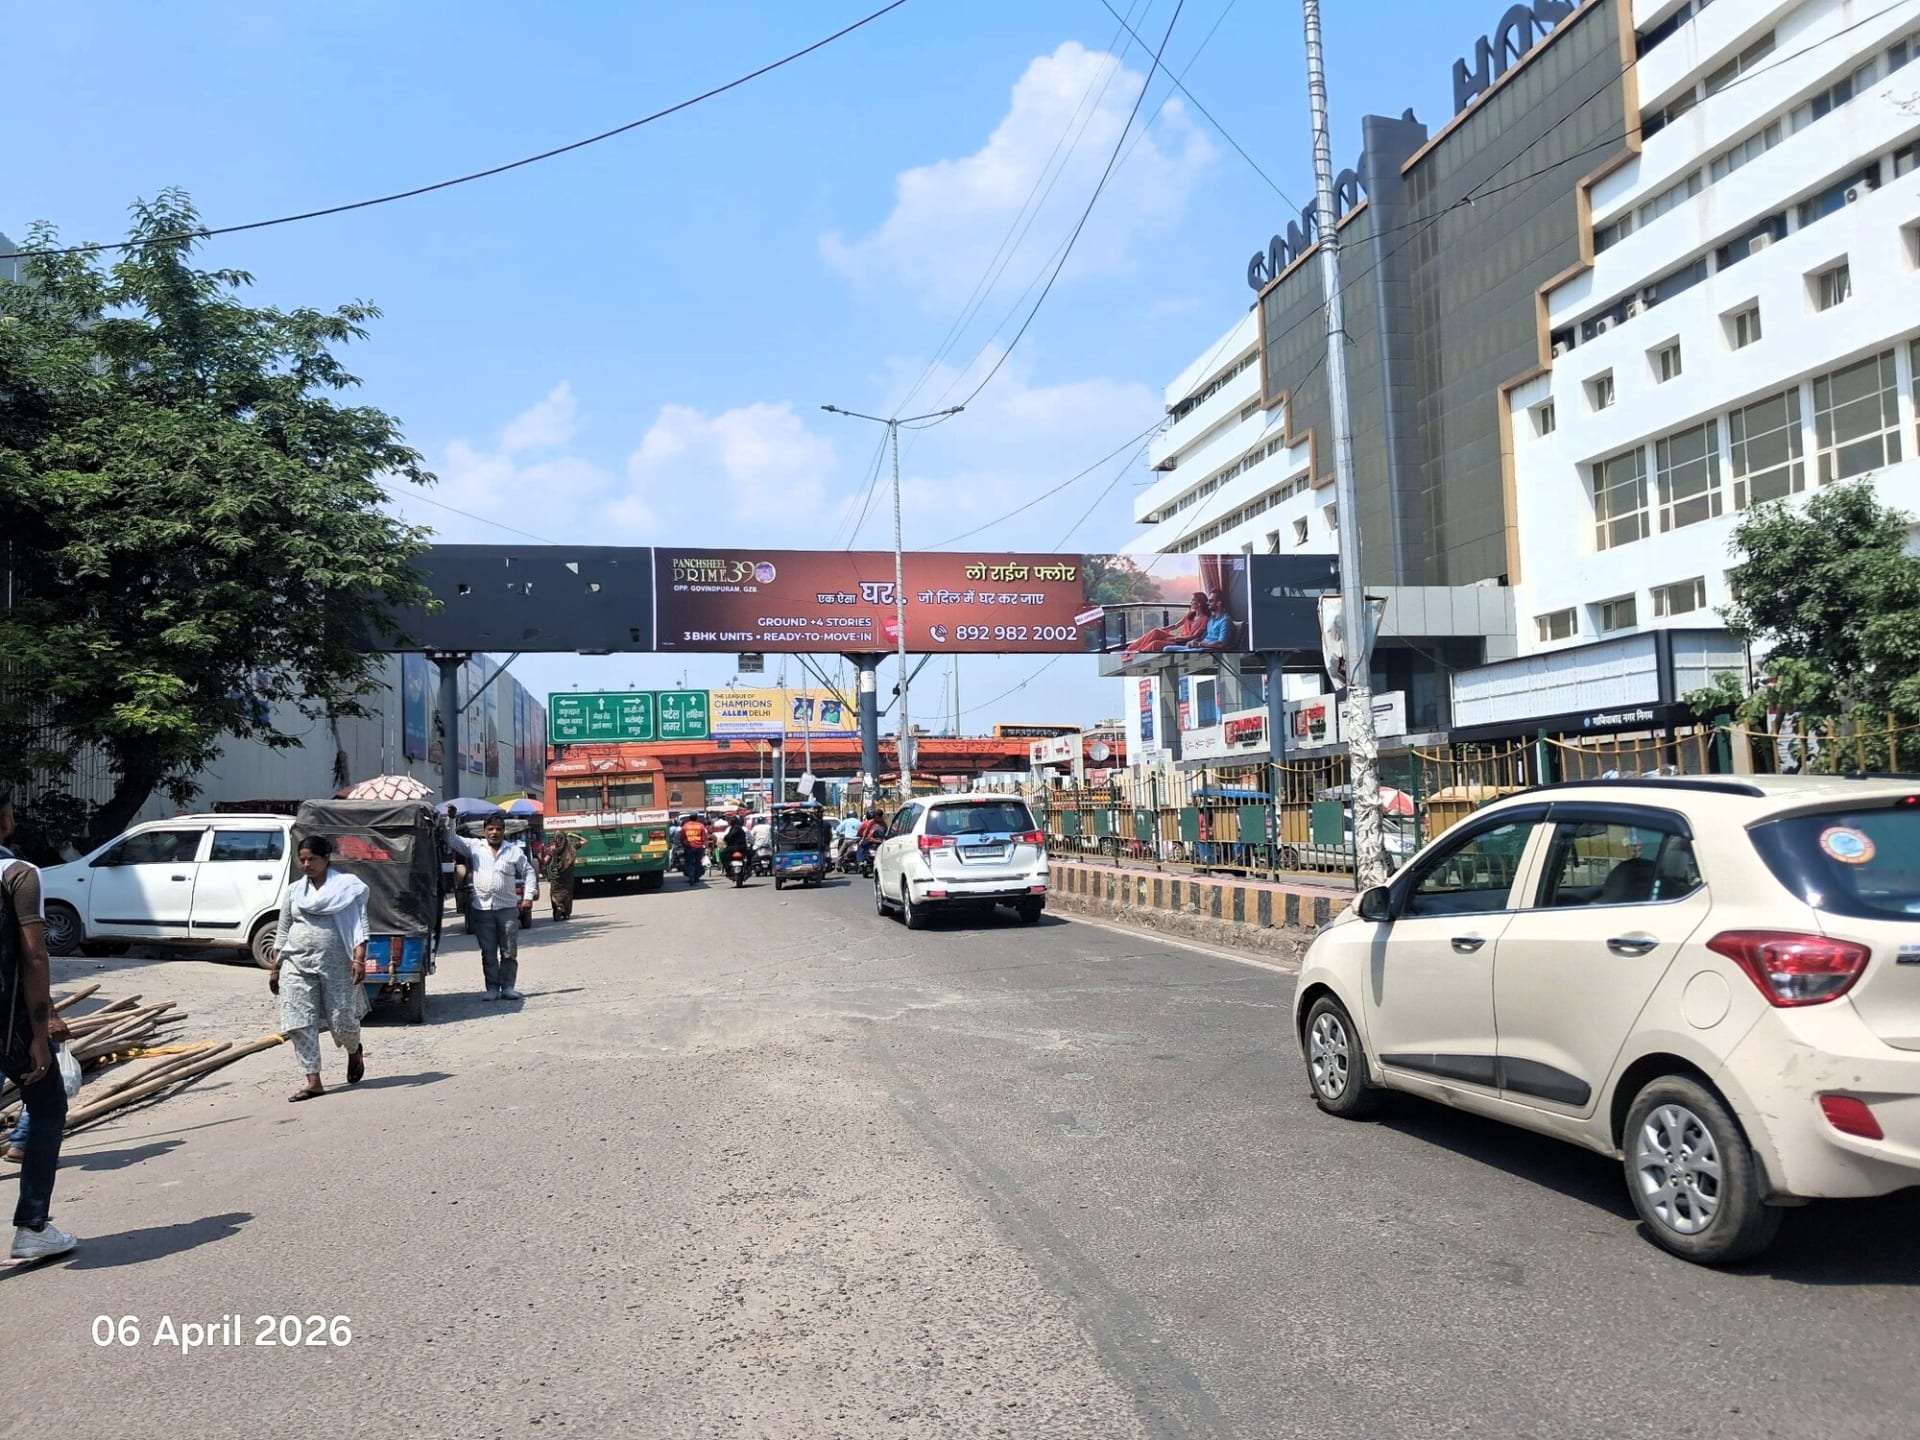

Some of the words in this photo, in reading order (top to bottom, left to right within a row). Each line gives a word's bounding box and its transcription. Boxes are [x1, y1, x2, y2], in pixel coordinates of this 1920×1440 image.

[673, 559, 727, 568] PANCHSHEEL
[674, 568, 727, 583] PRIME
[965, 562, 985, 580] लो
[991, 562, 1029, 582] राईज
[1034, 562, 1076, 581] फ्लोर
[691, 585, 742, 593] GOVINDPURAM,
[817, 594, 835, 604] एक
[836, 591, 857, 604] ऐसा
[917, 589, 933, 604] जो
[936, 590, 960, 604] दिल
[963, 589, 976, 604] में
[979, 593, 995, 604] घर
[998, 593, 1017, 604] कर
[1020, 593, 1045, 604] जाए
[757, 617, 807, 627] GROUND
[810, 617, 823, 626] +4
[826, 617, 872, 627] STORIES
[720, 632, 753, 641] UNITS
[956, 626, 990, 640] 892
[994, 626, 1028, 640] 982
[1032, 626, 1078, 641] 2002
[714, 699, 772, 708] CHAMPIONS
[663, 707, 680, 719] पटेल
[1623, 713, 1636, 722] नगर
[663, 722, 680, 732] नगर
